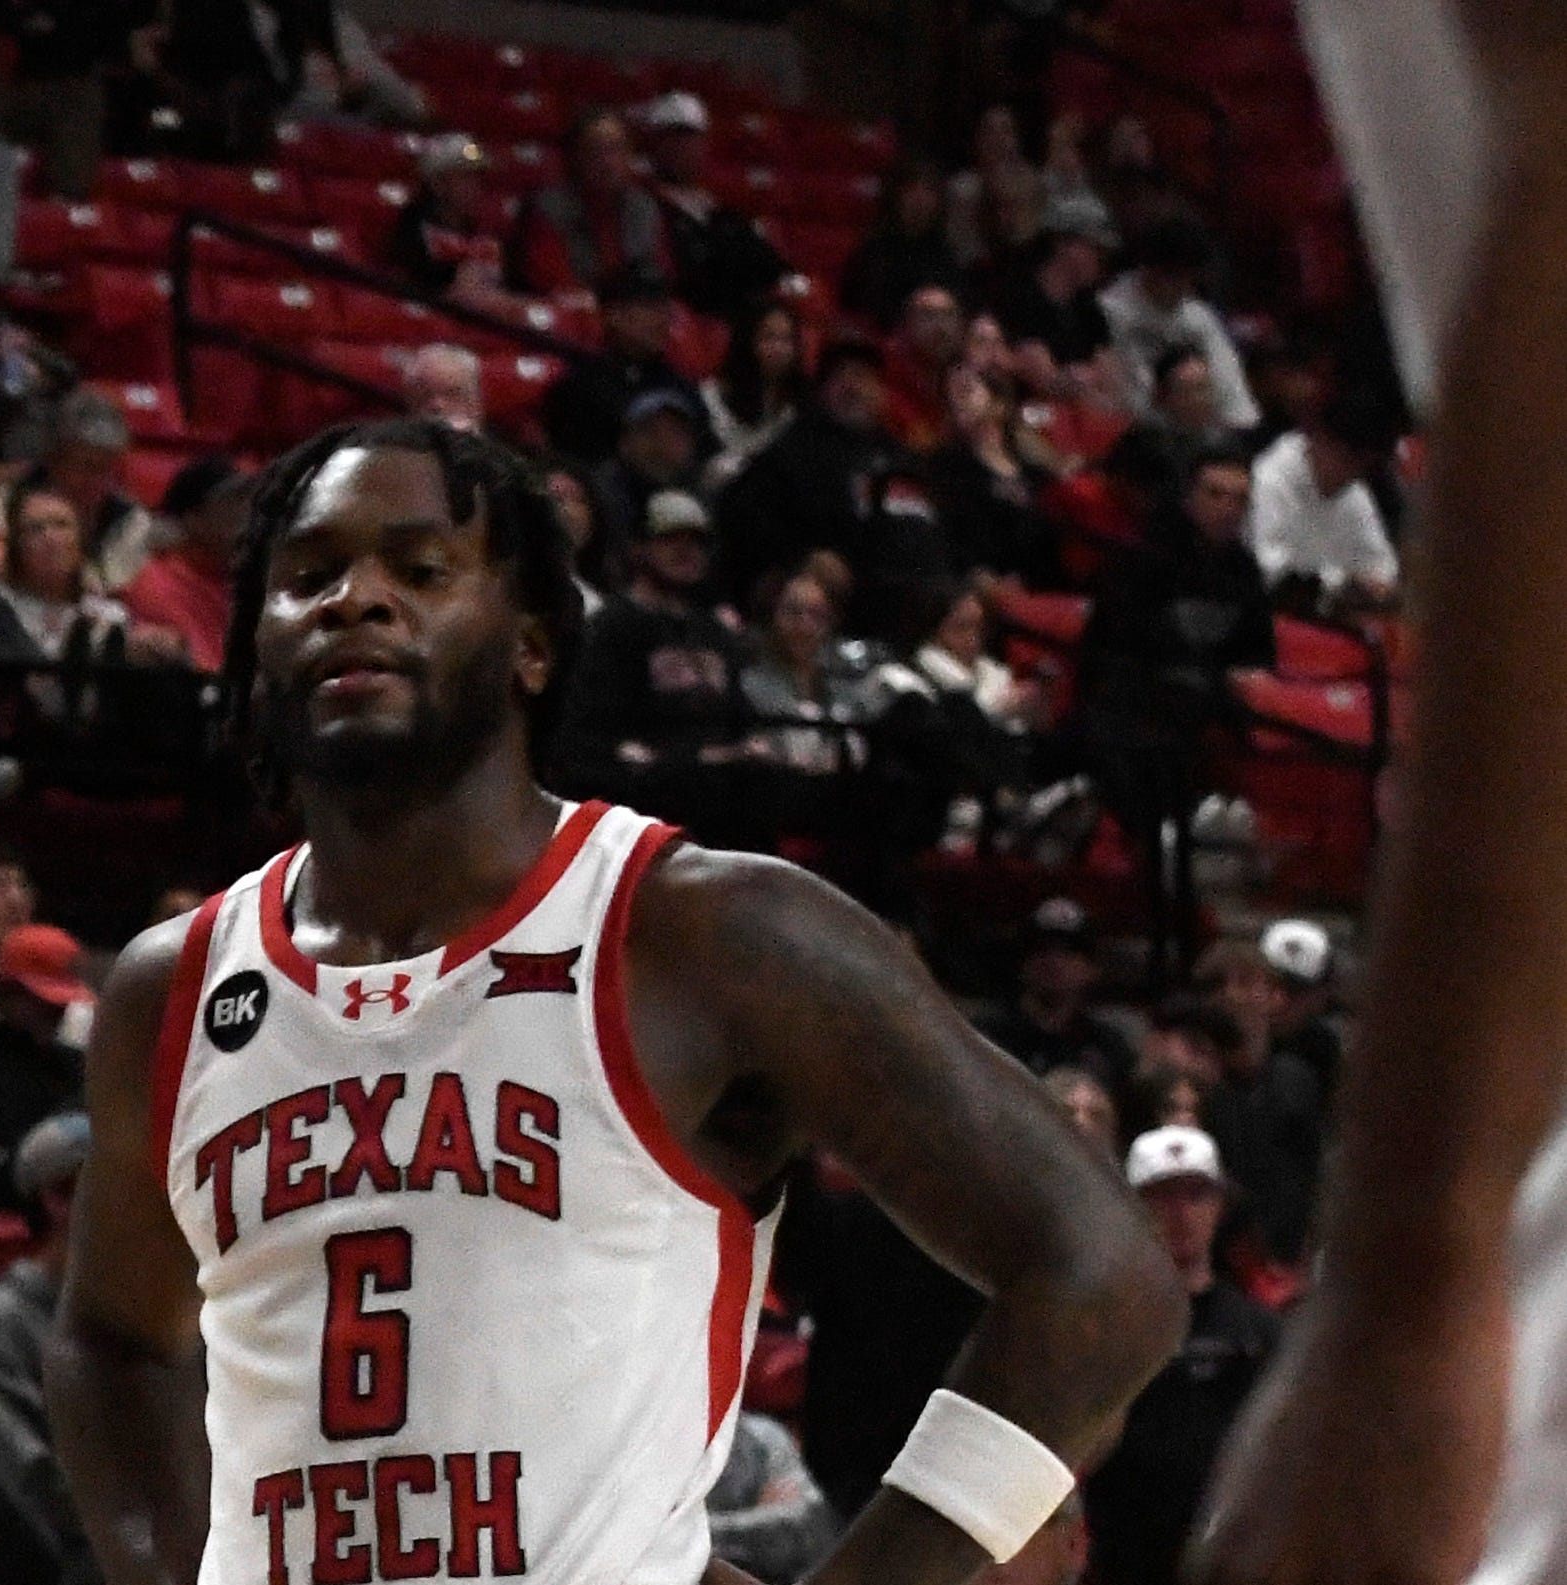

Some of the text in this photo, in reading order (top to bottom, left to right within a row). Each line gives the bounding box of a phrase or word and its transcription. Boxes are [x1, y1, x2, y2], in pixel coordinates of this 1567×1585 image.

[213, 988, 257, 1029] BK
[195, 1072, 561, 1256] TEXAS
[320, 1226, 412, 1440] 6
